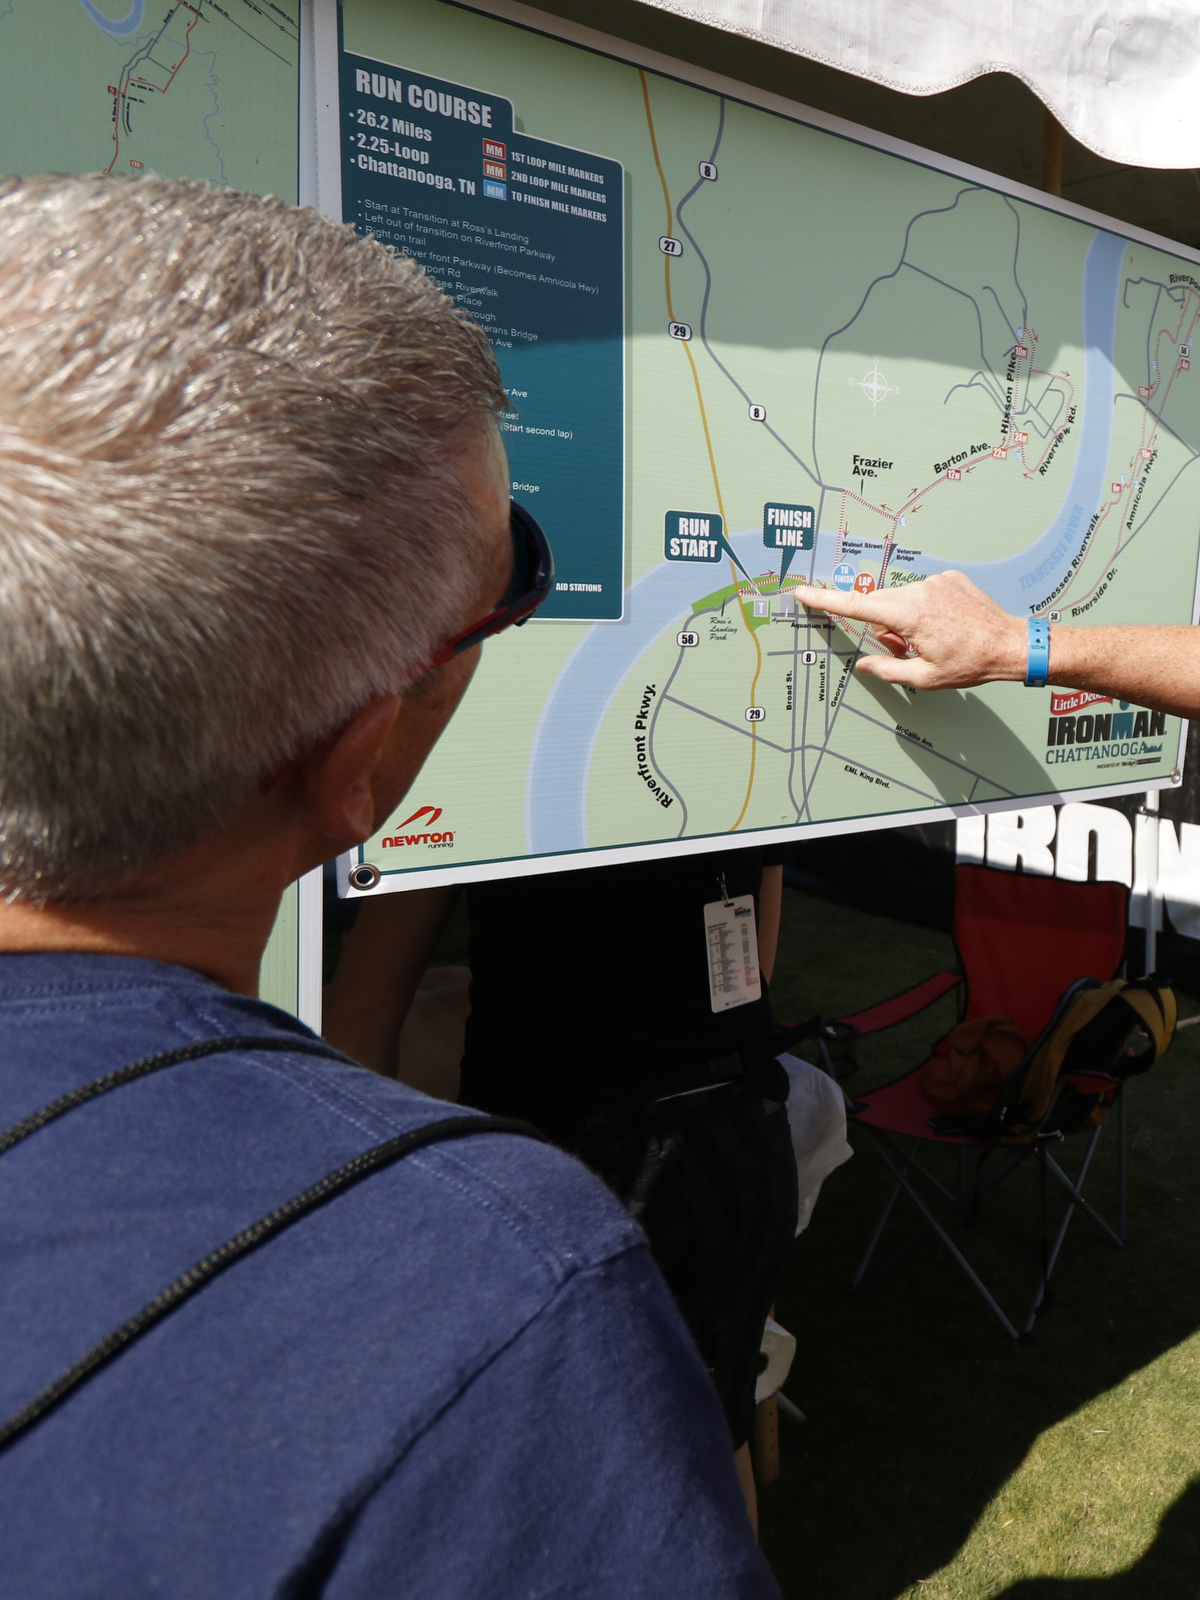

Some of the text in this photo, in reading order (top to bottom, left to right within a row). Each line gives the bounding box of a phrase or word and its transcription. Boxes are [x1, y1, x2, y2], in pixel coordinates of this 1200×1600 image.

[356, 68, 492, 128] RUN COURSE
[357, 109, 433, 141] 26.2 Miles
[357, 132, 430, 165] 2.25-Loop
[485, 143, 503, 158] MM
[358, 154, 476, 196] Chattanooga, TN
[486, 164, 504, 178] MM
[511, 151, 605, 184] 1ST LOOP MILE MARKERS
[704, 165, 711, 177] 8
[486, 184, 504, 198] MM
[511, 171, 607, 204] 2ND LOOP MILE MARKERS
[511, 190, 607, 223] TO FINISH MILE MARKERS
[364, 199, 529, 245] Start at Transition at Ross's Landing
[364, 212, 556, 262] Left out of transition on Riverfront Parkway
[365, 225, 426, 246] Right on trail
[664, 240, 676, 253] 27
[402, 246, 427, 258] River
[430, 251, 451, 263] front
[452, 256, 492, 273] Parkway
[493, 265, 537, 281] (Becomes
[538, 274, 576, 289] Amnicola
[578, 282, 599, 295] Hwy)
[447, 267, 461, 277] Rd
[455, 281, 498, 297] Riverwalk
[457, 294, 482, 306] Place
[510, 328, 538, 341] Bridge
[673, 325, 687, 338] 29
[495, 339, 513, 348] Ave
[511, 388, 528, 398] Ave
[1000, 352, 1017, 434] Hixson Pike
[753, 407, 760, 418] 8
[500, 422, 573, 440] (Start second lap)
[1038, 405, 1077, 476] Riverview Rd.
[852, 455, 894, 470] Frazier
[933, 442, 991, 474] Barton Ave.
[852, 466, 878, 478] Ave.
[512, 481, 540, 493] Bridge
[1126, 477, 1147, 530] Amnicola
[767, 508, 812, 528] FINISH
[679, 517, 710, 537] RUN
[775, 529, 803, 547] LINE
[1019, 502, 1084, 591] TENNESSEE RIVER
[670, 538, 717, 558] START
[841, 566, 849, 574] TO
[1029, 513, 1100, 614] Tennessee Riverwalk
[556, 582, 602, 593] AID STATIONS
[834, 575, 855, 584] FINISH
[858, 576, 872, 586] LAP
[1071, 567, 1118, 617] Riverside Dr.
[758, 602, 764, 614] T
[709, 625, 738, 634] Landing
[823, 623, 836, 631] Way
[681, 635, 694, 645] 58
[709, 633, 728, 641] Park
[806, 653, 811, 663] 8
[831, 656, 853, 707] Georgia Ave.
[1053, 697, 1079, 711] Little
[749, 709, 761, 719] 29
[1047, 708, 1164, 746] IRONMAN
[895, 724, 934, 749] McCallie Ave.
[634, 684, 674, 809] Riverfront Pkwy.
[1045, 741, 1148, 765] CHATTANOOGA
[859, 771, 874, 783] King
[874, 778, 891, 789] Blvd.
[382, 831, 454, 848] NEWTON
